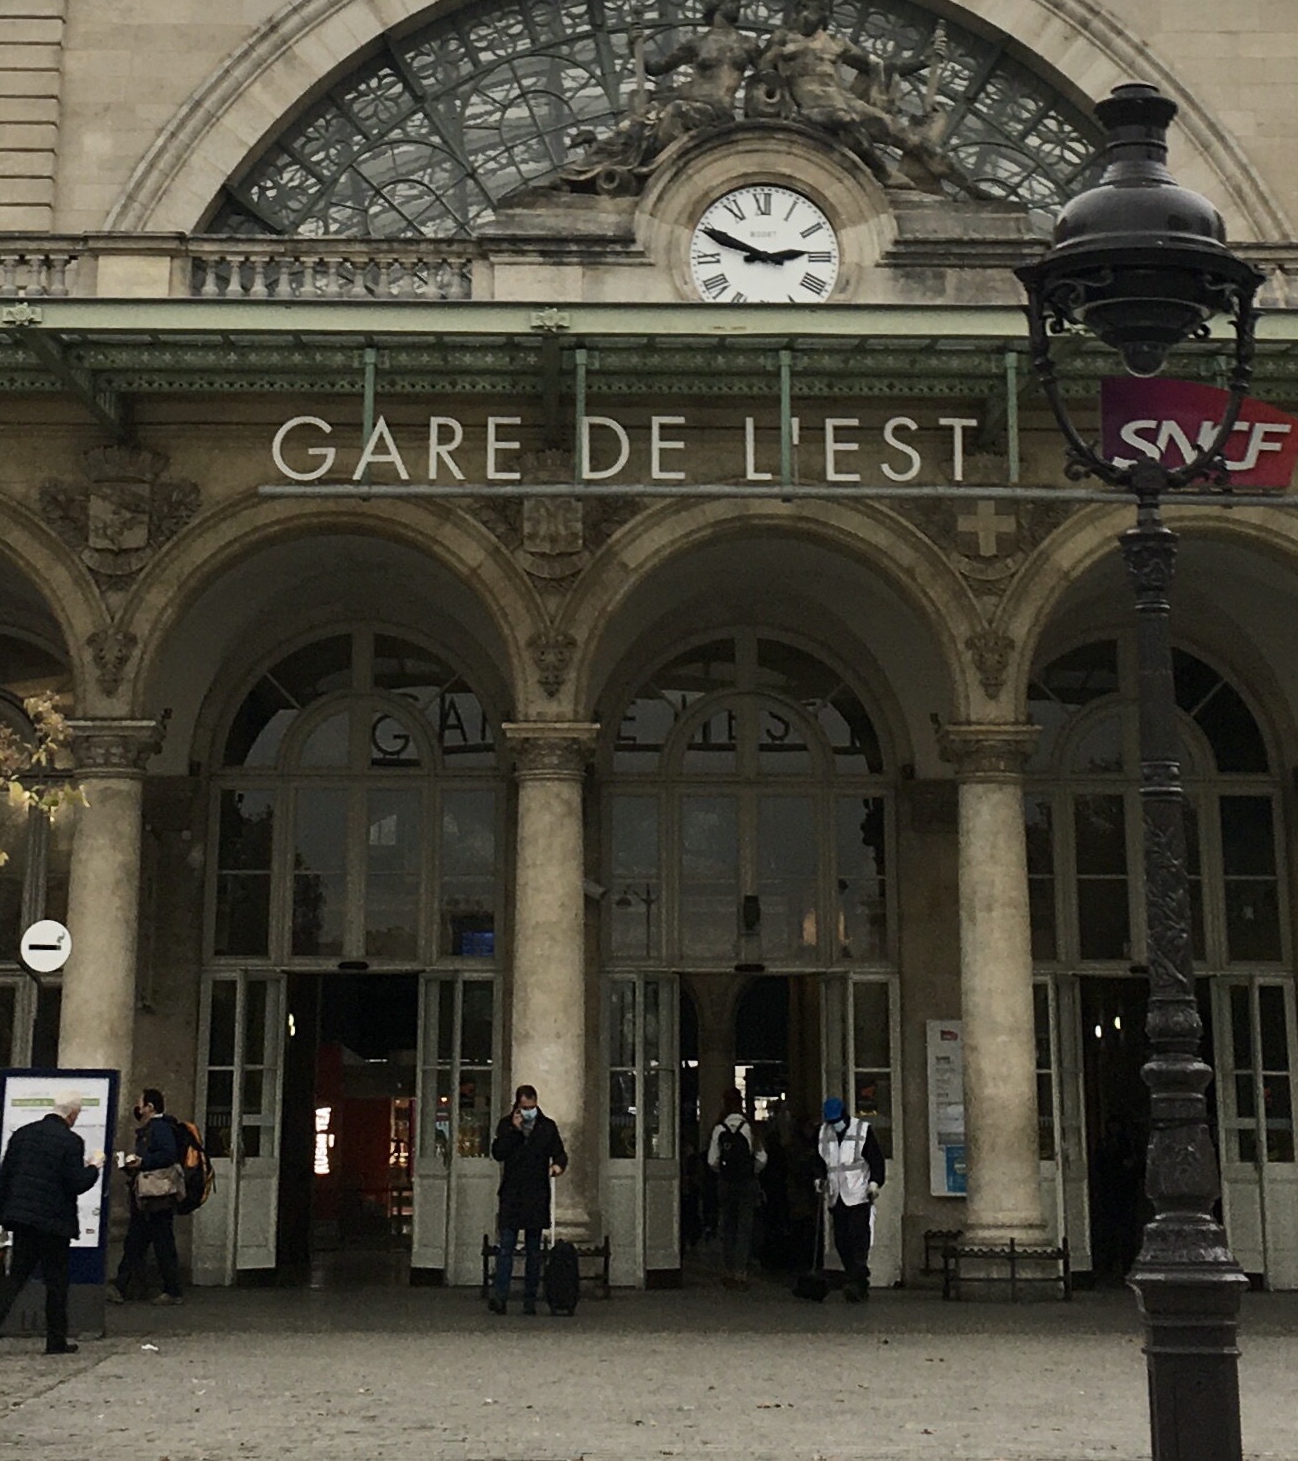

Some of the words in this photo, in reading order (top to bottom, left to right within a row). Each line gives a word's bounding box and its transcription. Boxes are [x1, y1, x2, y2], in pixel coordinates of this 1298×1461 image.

[272, 415, 522, 481] GARE
[581, 416, 686, 481] DE
[745, 416, 978, 482] L'EST
[1112, 419, 1292, 471] SNCF
[315, 1107, 332, 1132] TEA
